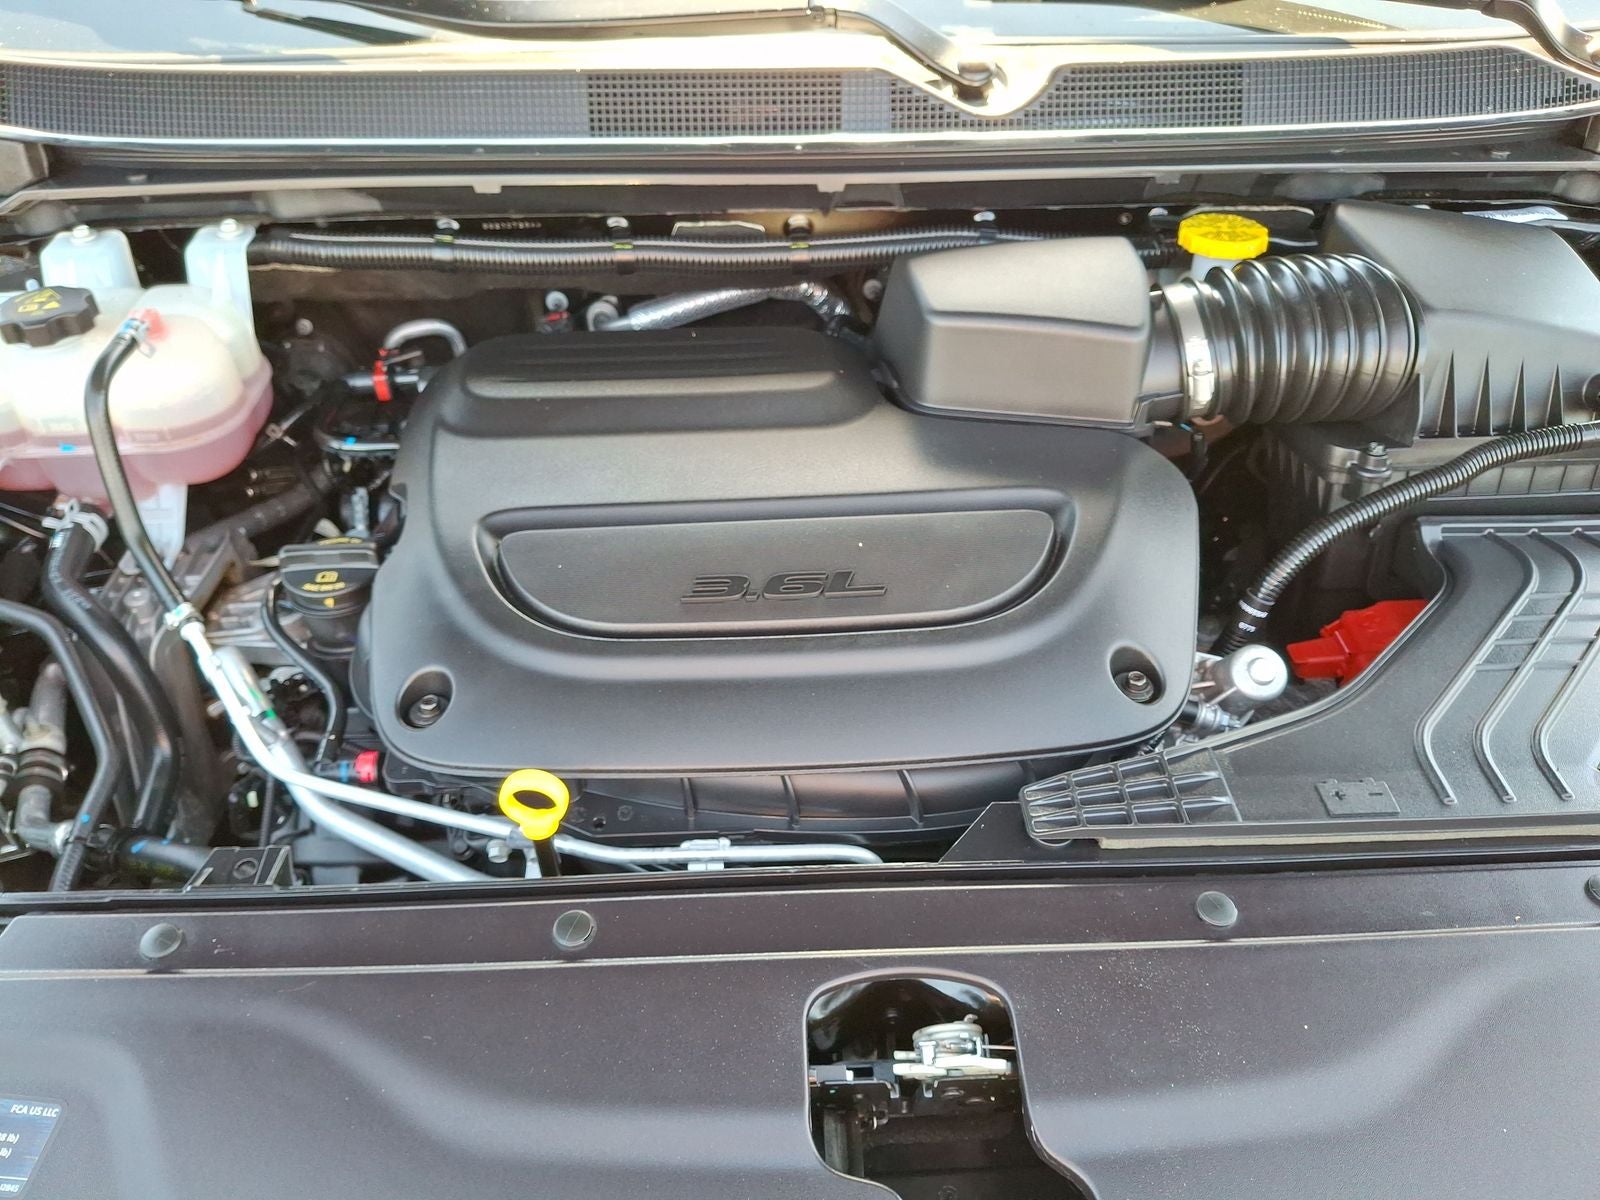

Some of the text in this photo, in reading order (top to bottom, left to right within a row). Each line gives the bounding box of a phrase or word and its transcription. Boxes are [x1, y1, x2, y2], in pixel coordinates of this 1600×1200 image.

[680, 569, 888, 603] 3.6L
[10, 1104, 59, 1117] FCA US LLC
